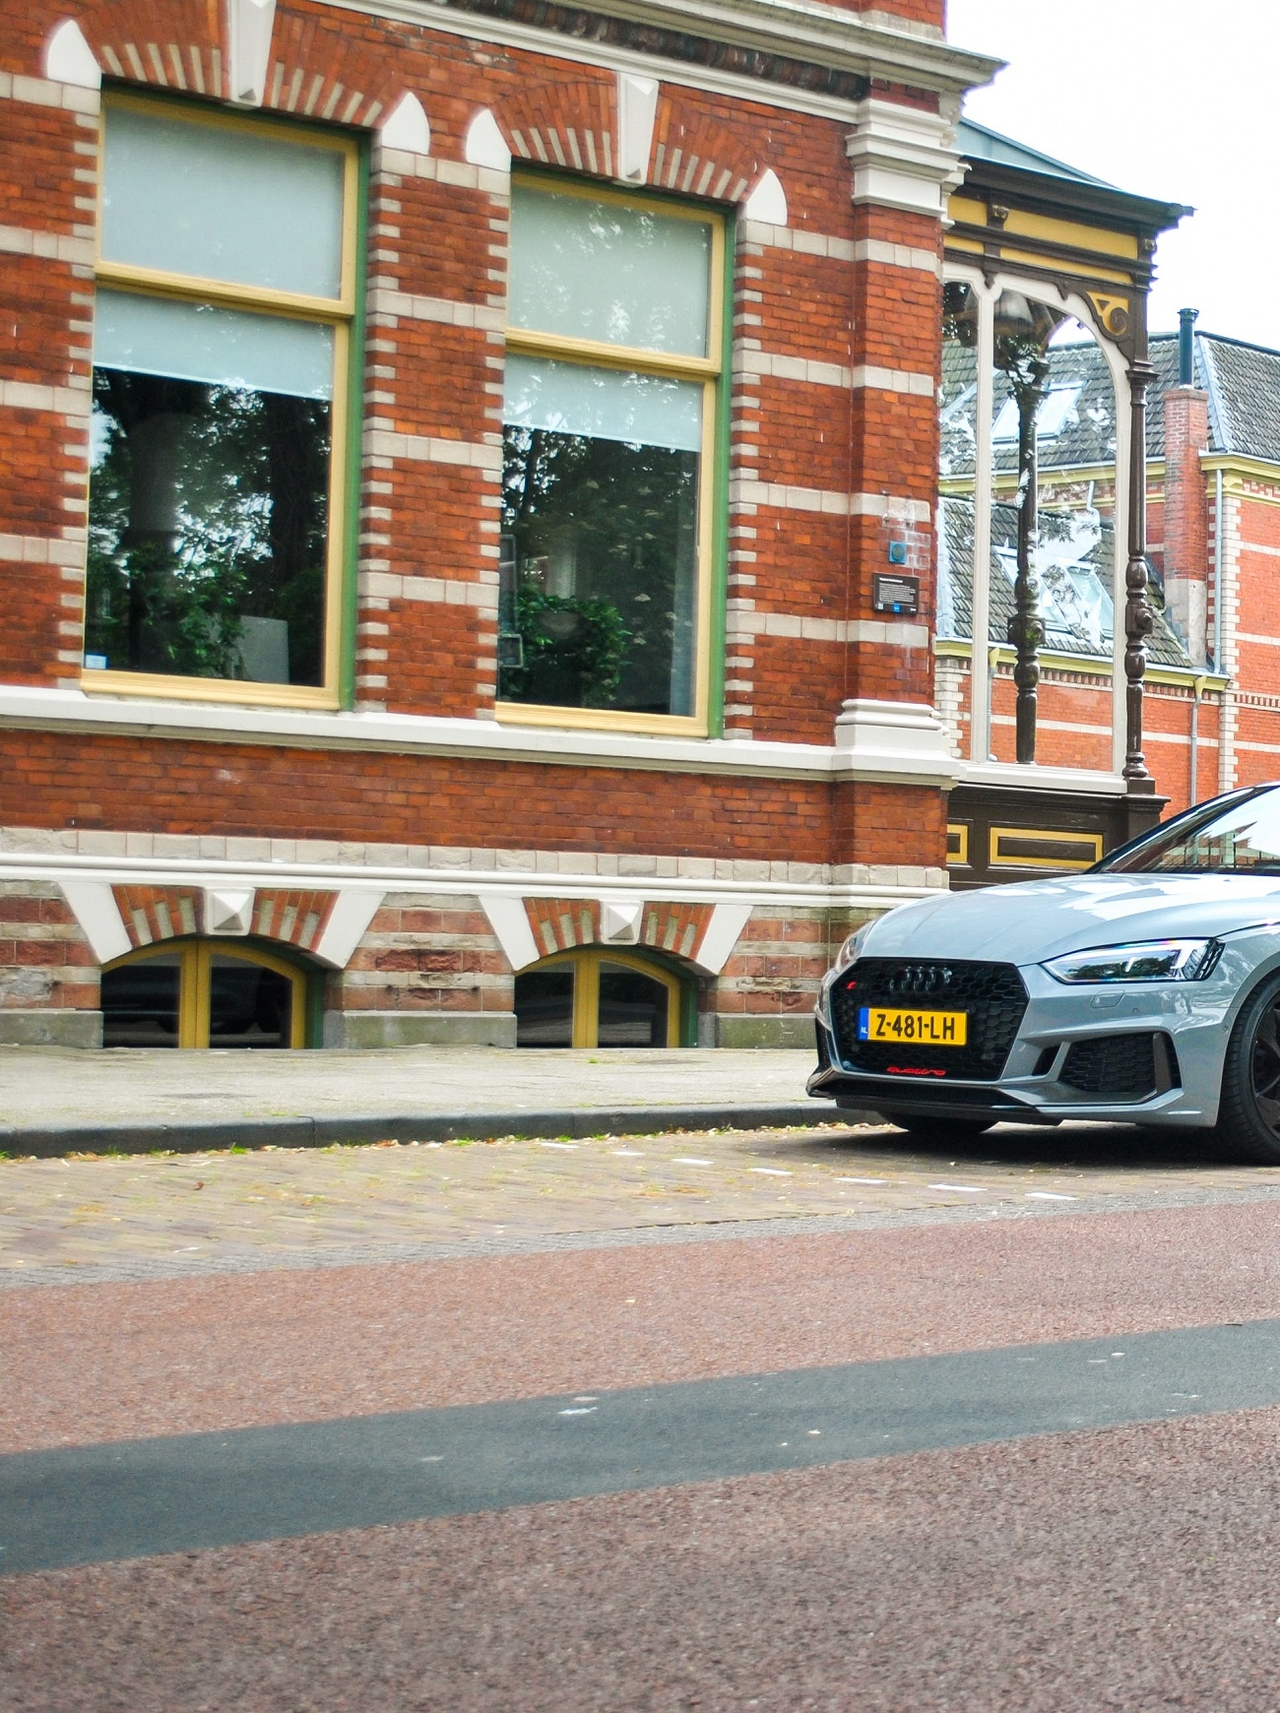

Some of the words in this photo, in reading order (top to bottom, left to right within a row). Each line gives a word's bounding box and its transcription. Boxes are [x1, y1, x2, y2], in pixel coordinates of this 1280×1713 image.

[860, 1026, 868, 1034] NL
[876, 1013, 955, 1040] Z-481-LH
[886, 1066, 946, 1076] quattro
